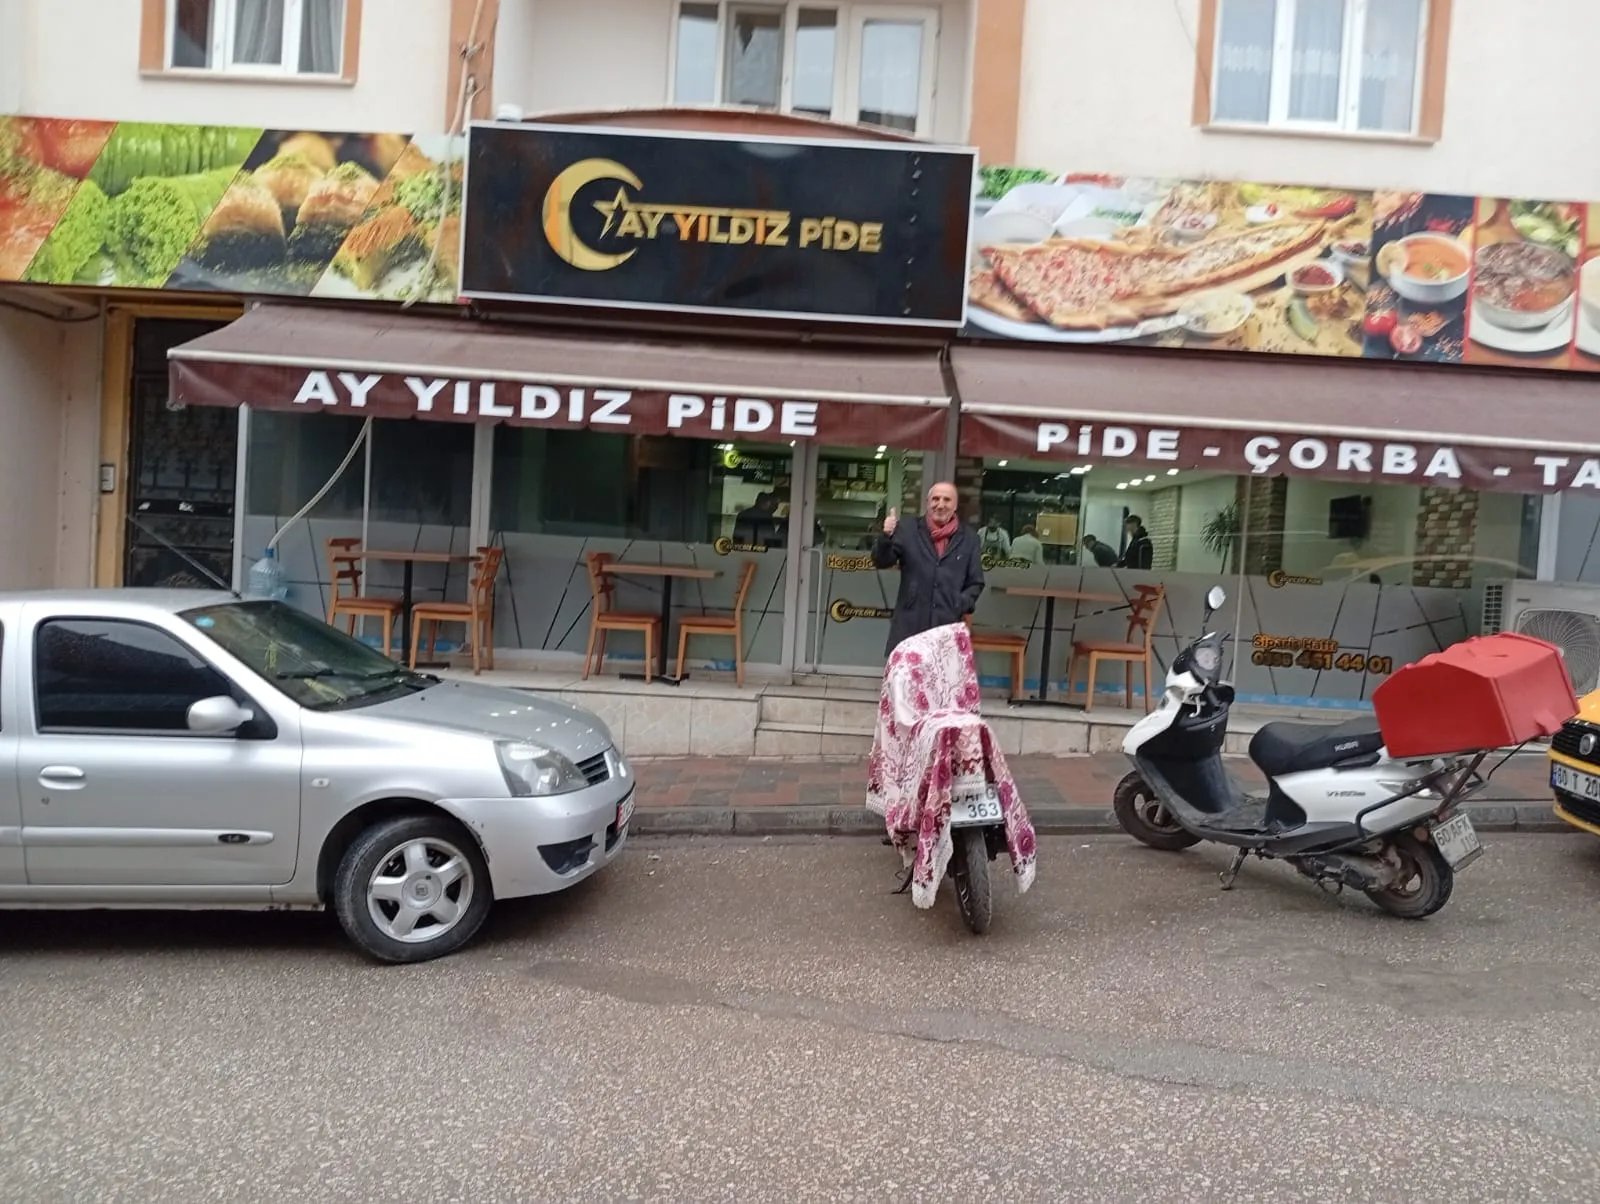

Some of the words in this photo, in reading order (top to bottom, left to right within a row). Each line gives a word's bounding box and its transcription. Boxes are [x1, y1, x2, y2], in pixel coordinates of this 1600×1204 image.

[615, 211, 666, 239] AY
[673, 210, 790, 246] YILDIZ
[294, 371, 382, 408] AY
[404, 377, 632, 425] YILDIZ
[1244, 436, 1463, 479] ÇORBA
[1335, 654, 1364, 671] 44
[1368, 656, 1393, 674] 01
[1572, 772, 1580, 790] T
[967, 802, 998, 818] 363
[1436, 828, 1451, 846] 60
